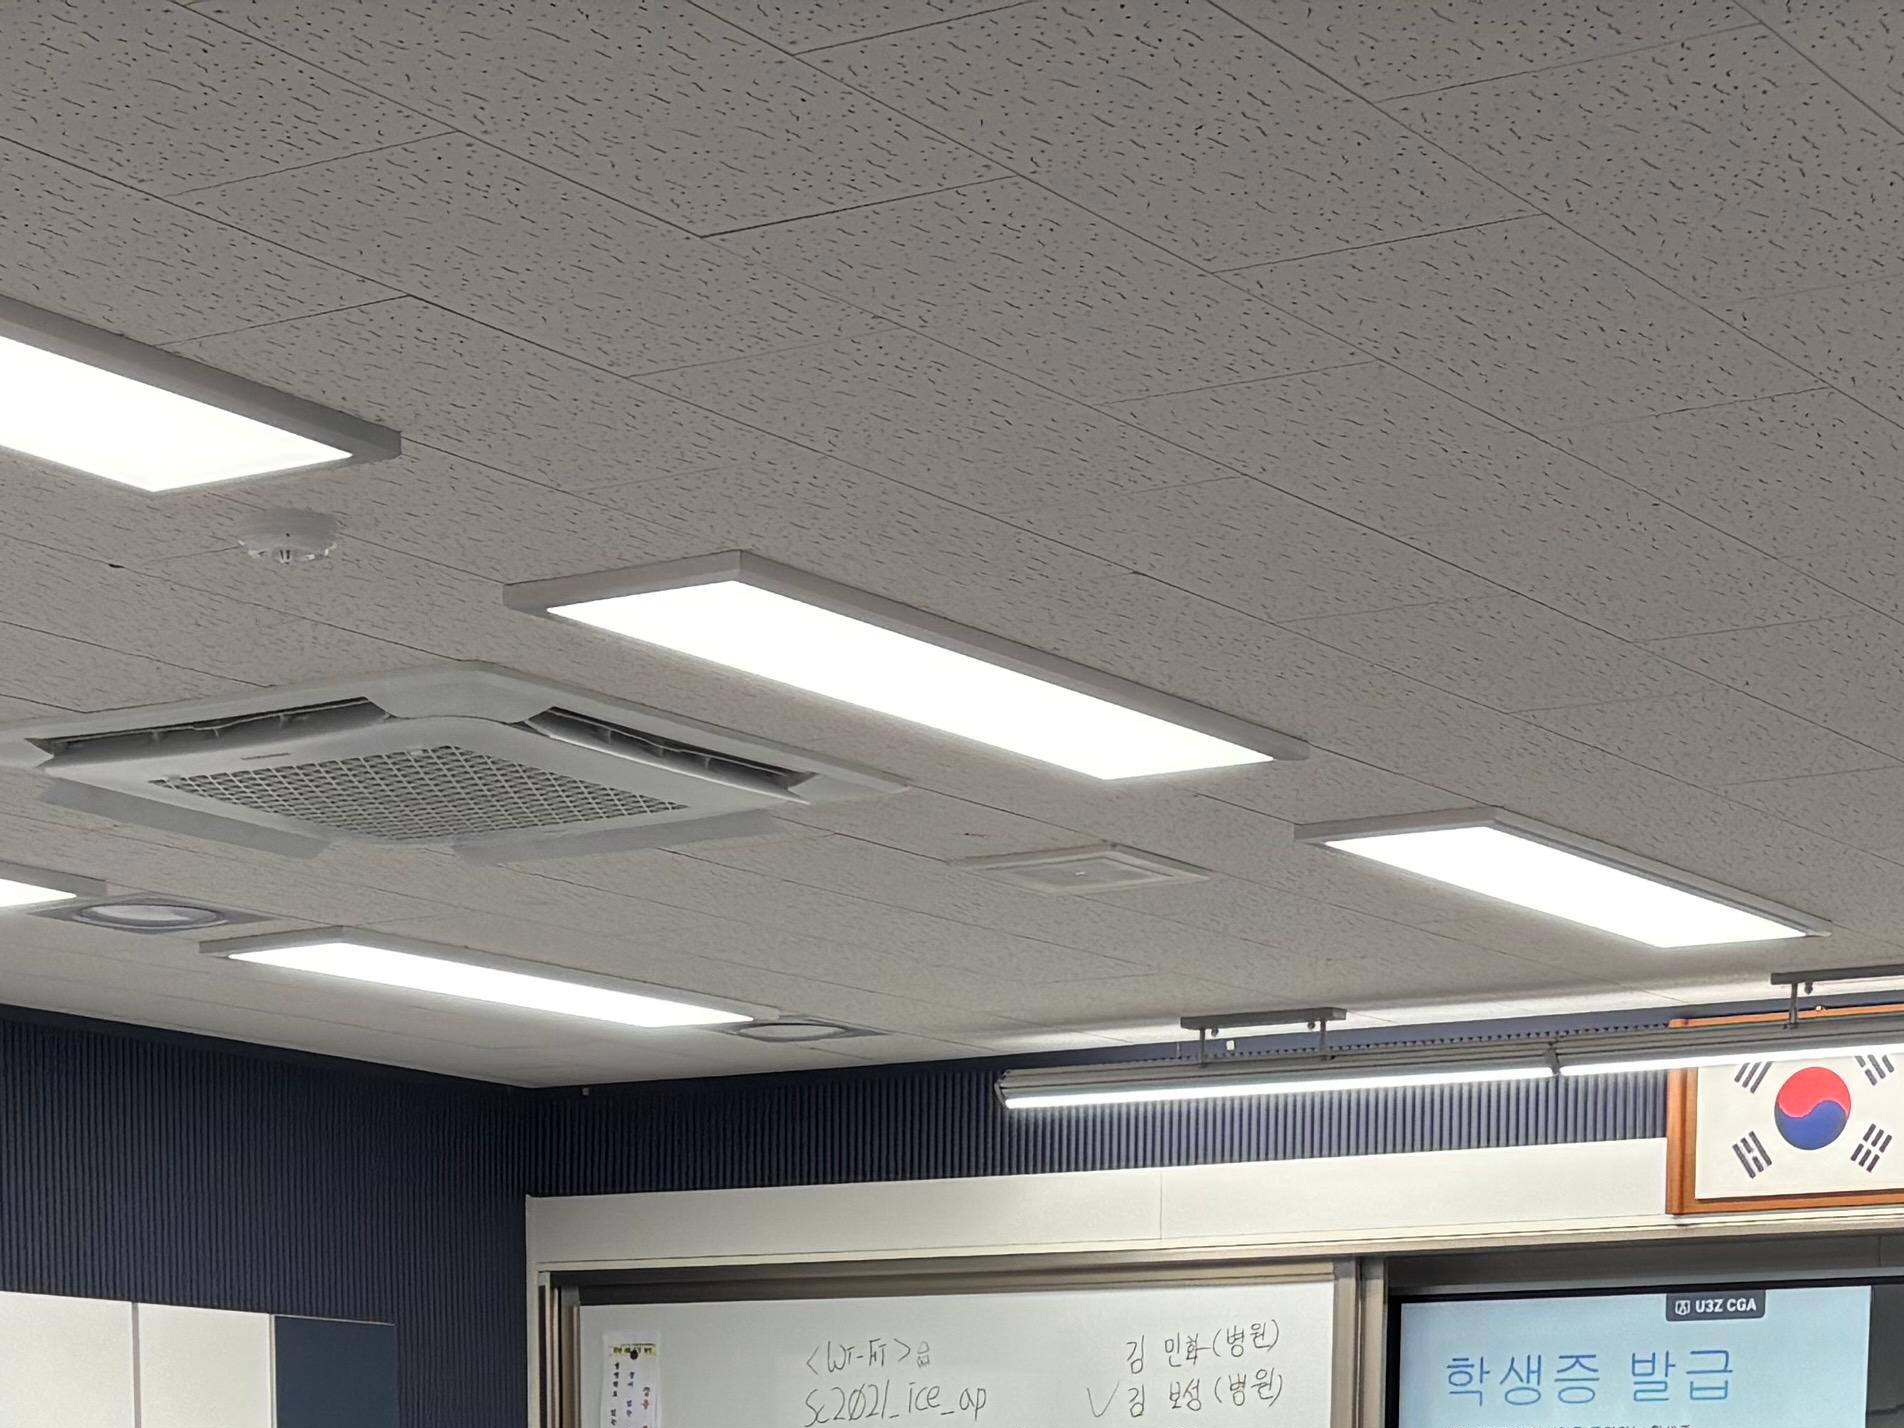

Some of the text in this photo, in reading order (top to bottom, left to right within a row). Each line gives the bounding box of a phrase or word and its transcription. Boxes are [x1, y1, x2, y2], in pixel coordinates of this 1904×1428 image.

[1726, 1297, 1757, 1312] CGA
[1126, 1335, 1145, 1374] 김
[1128, 1385, 1145, 1418] 김
[1214, 1367, 1284, 1408] (병원)
[1445, 1349, 1735, 1408] 학생증 발급
